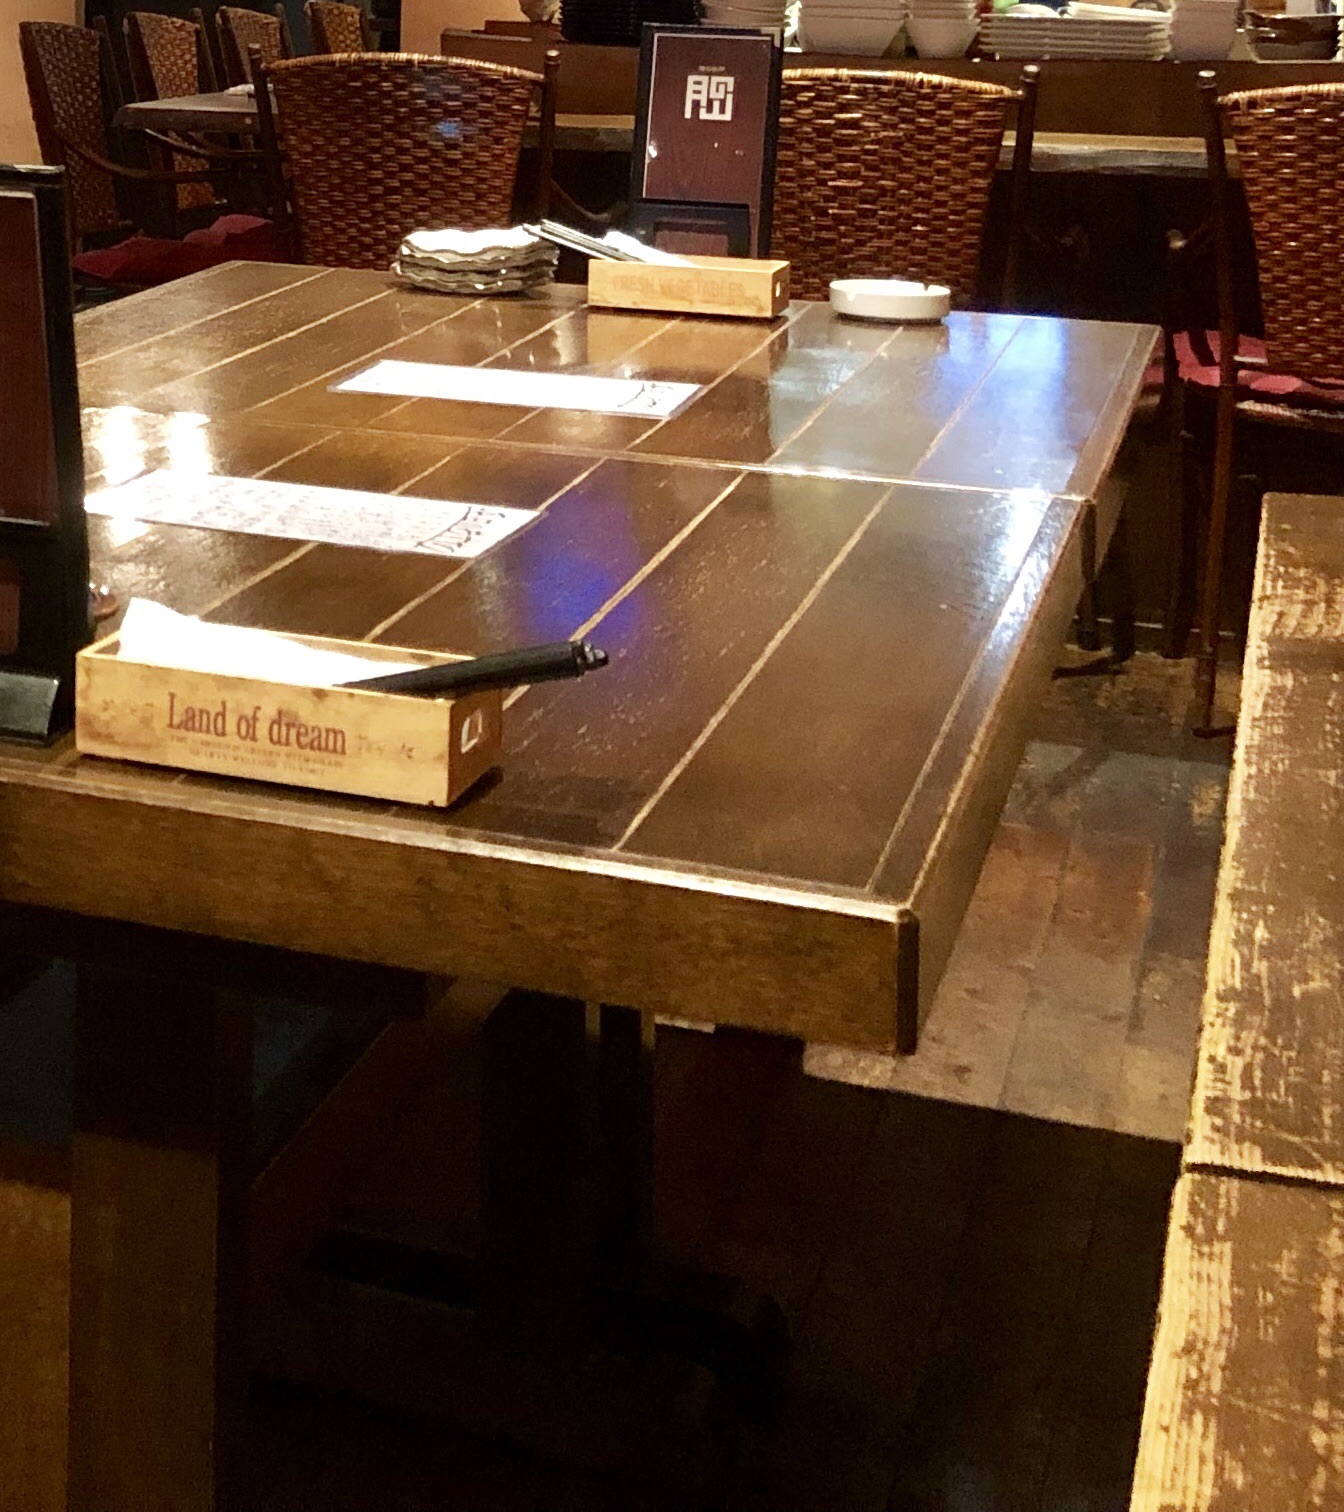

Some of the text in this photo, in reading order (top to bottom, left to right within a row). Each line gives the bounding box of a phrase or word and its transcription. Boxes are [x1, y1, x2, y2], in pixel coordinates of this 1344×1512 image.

[166, 691, 227, 738] Land
[236, 705, 262, 743] of
[268, 708, 347, 756] dream
